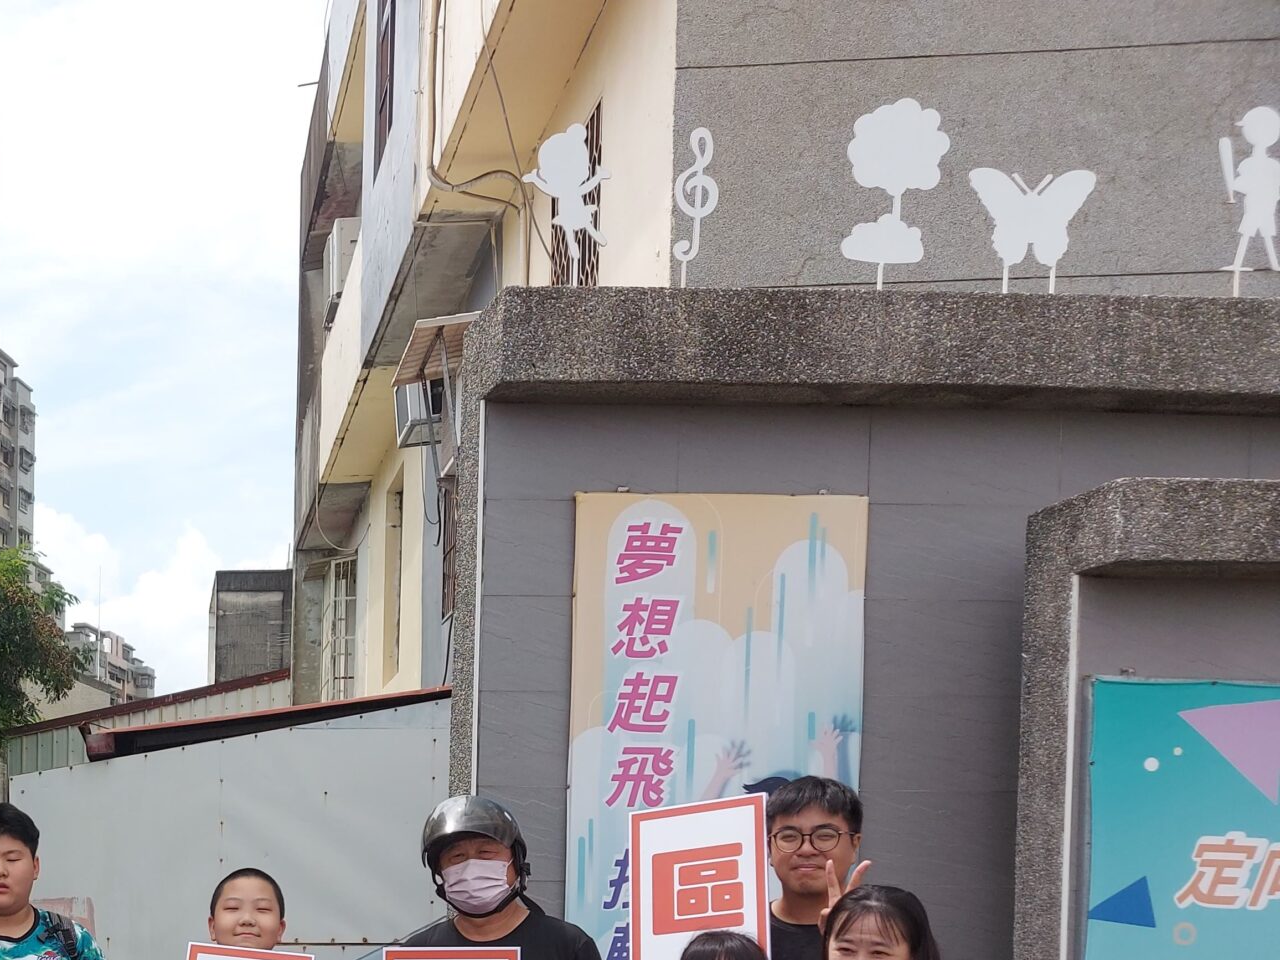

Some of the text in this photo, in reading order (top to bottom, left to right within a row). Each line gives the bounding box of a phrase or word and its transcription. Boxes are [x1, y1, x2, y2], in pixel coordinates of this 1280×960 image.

[605, 521, 684, 808] 夢想起飛
[651, 841, 745, 936] 區
